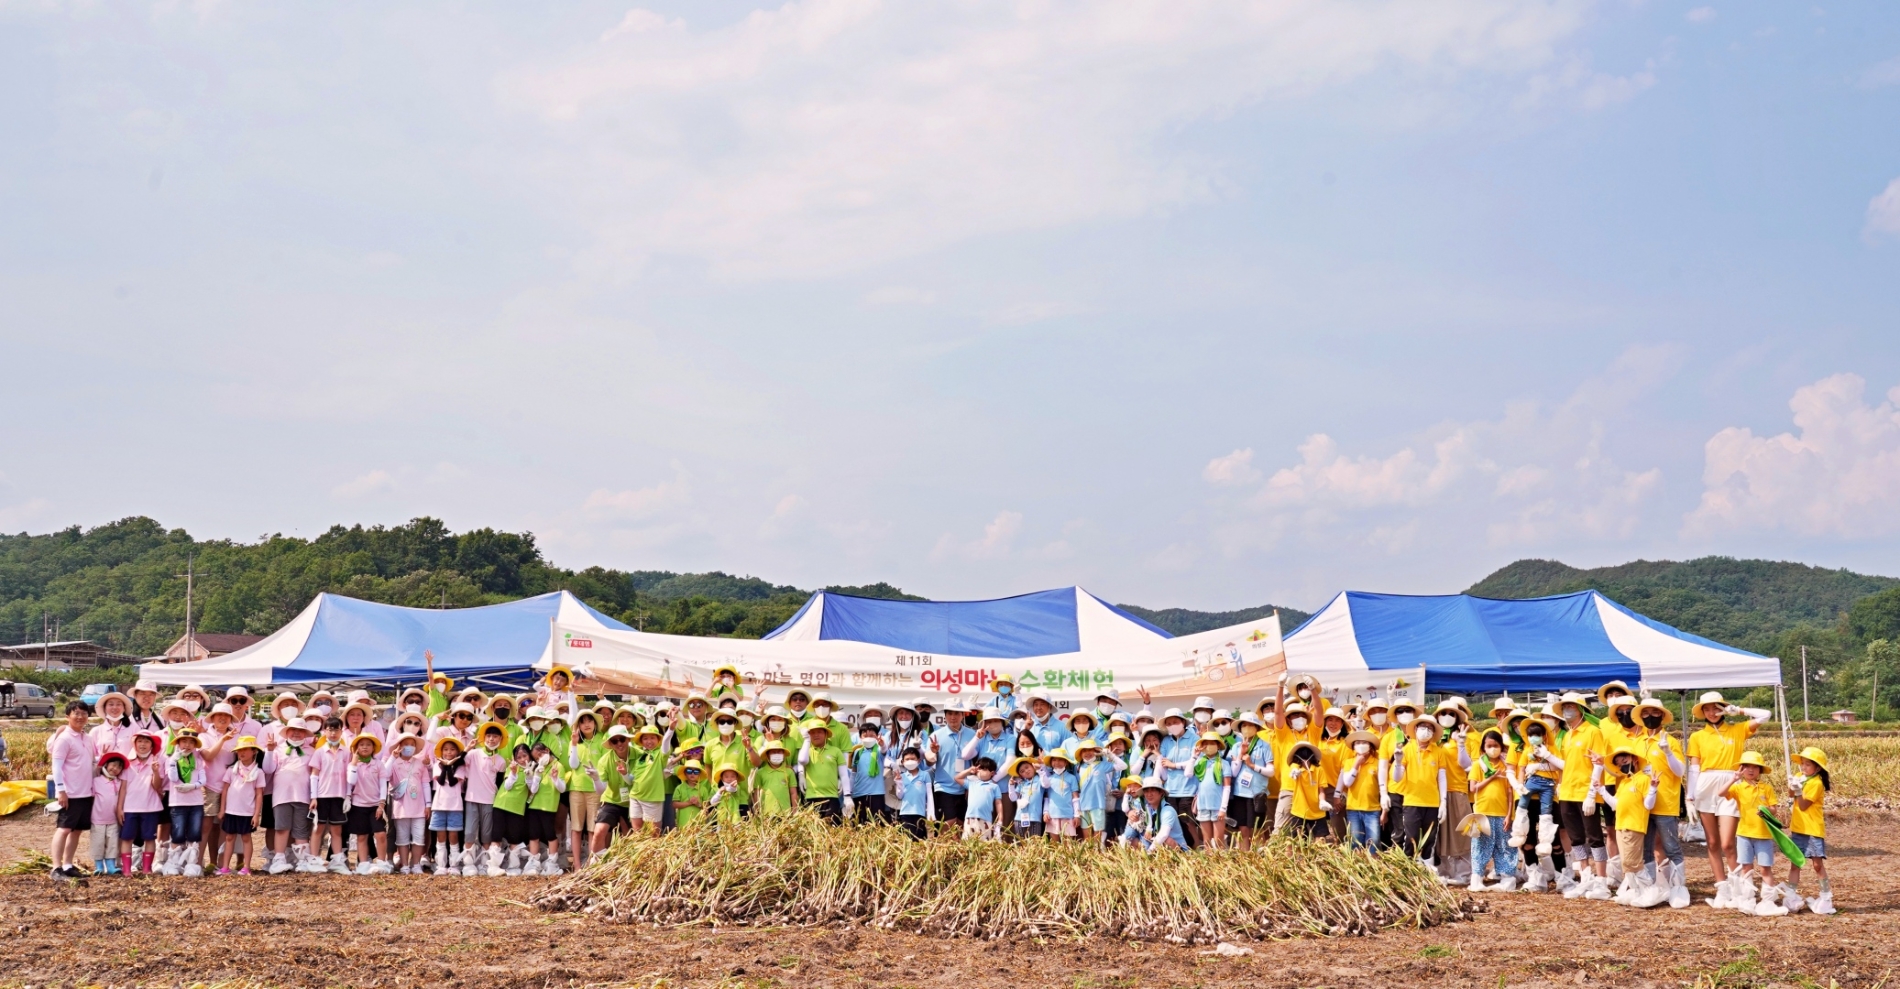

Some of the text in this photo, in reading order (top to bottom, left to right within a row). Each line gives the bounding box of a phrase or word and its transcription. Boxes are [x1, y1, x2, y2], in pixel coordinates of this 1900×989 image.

[895, 655, 932, 666] 제 11회
[800, 671, 845, 688] 명인과
[852, 672, 914, 688] 함께하는
[1019, 669, 1114, 692] 수확체험
